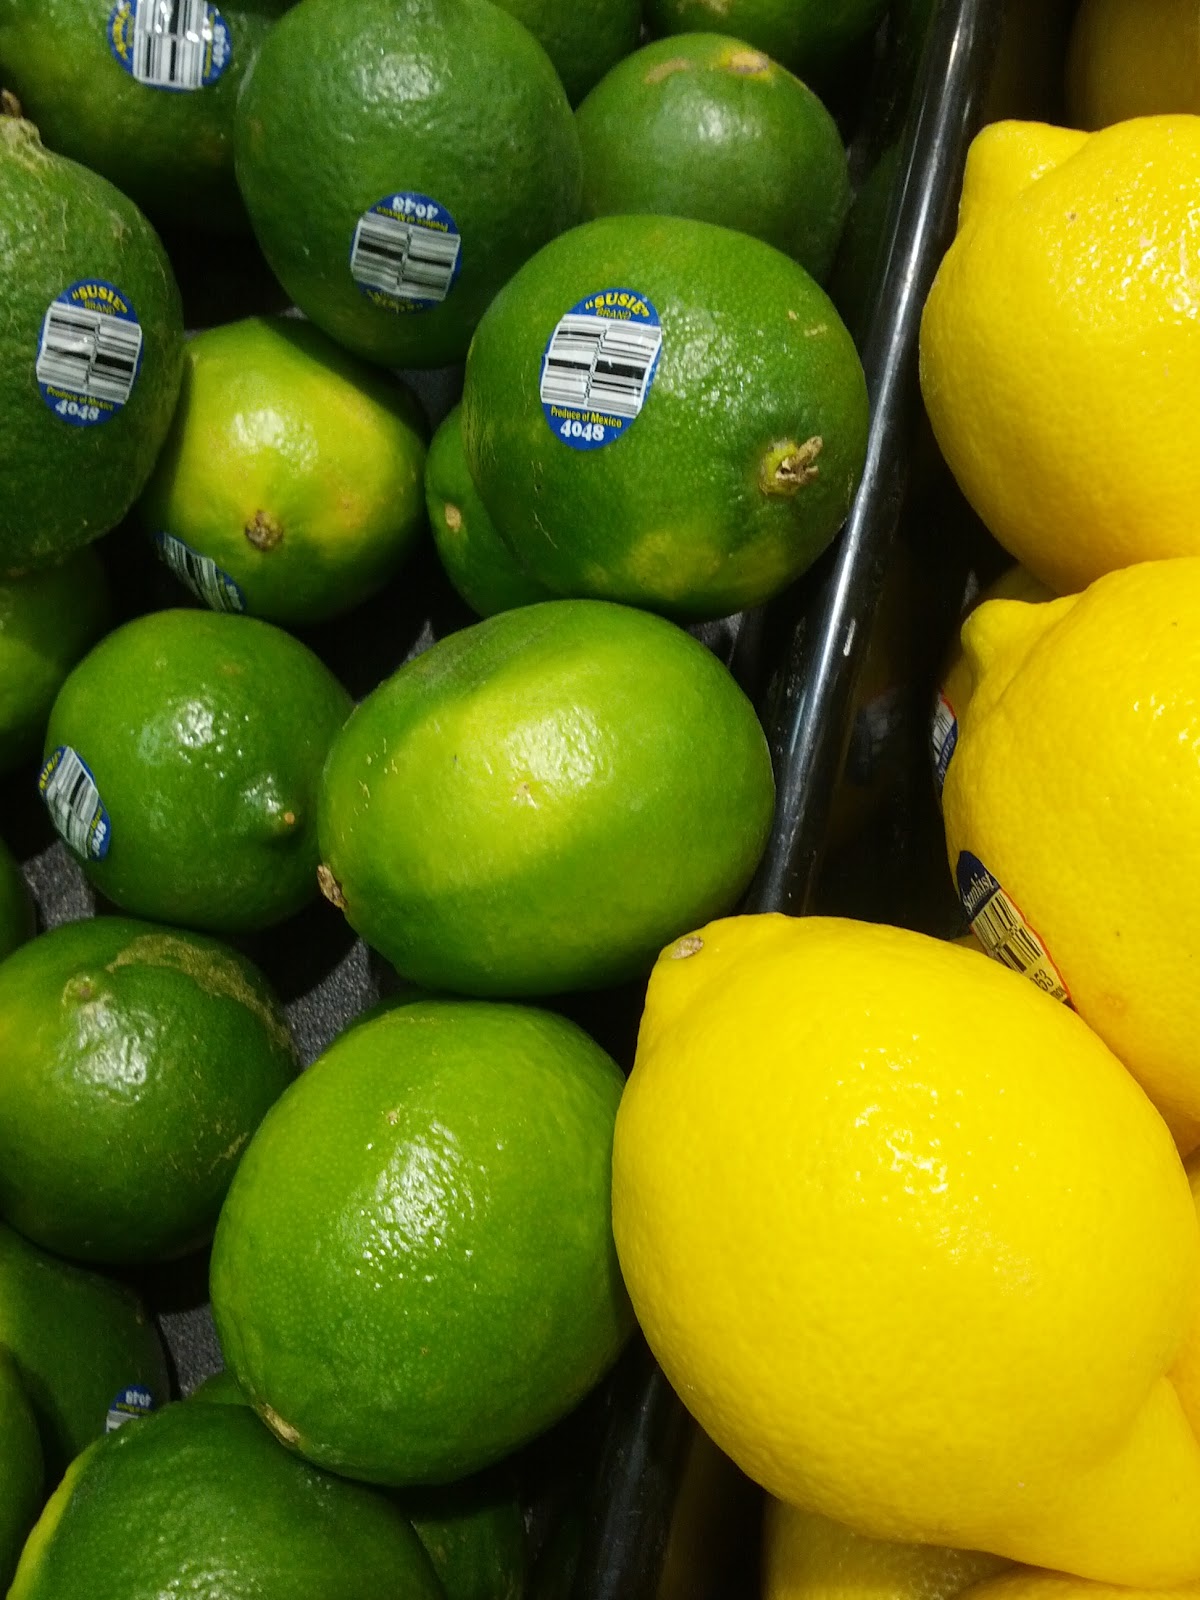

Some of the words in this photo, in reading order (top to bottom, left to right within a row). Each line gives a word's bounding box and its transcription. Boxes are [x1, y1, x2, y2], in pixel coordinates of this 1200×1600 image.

[393, 196, 438, 220] 4048
[55, 399, 100, 421] 4048
[551, 405, 580, 420] Produce
[582, 411, 590, 422] of
[591, 412, 622, 428] Mexico
[560, 419, 605, 442] 4048
